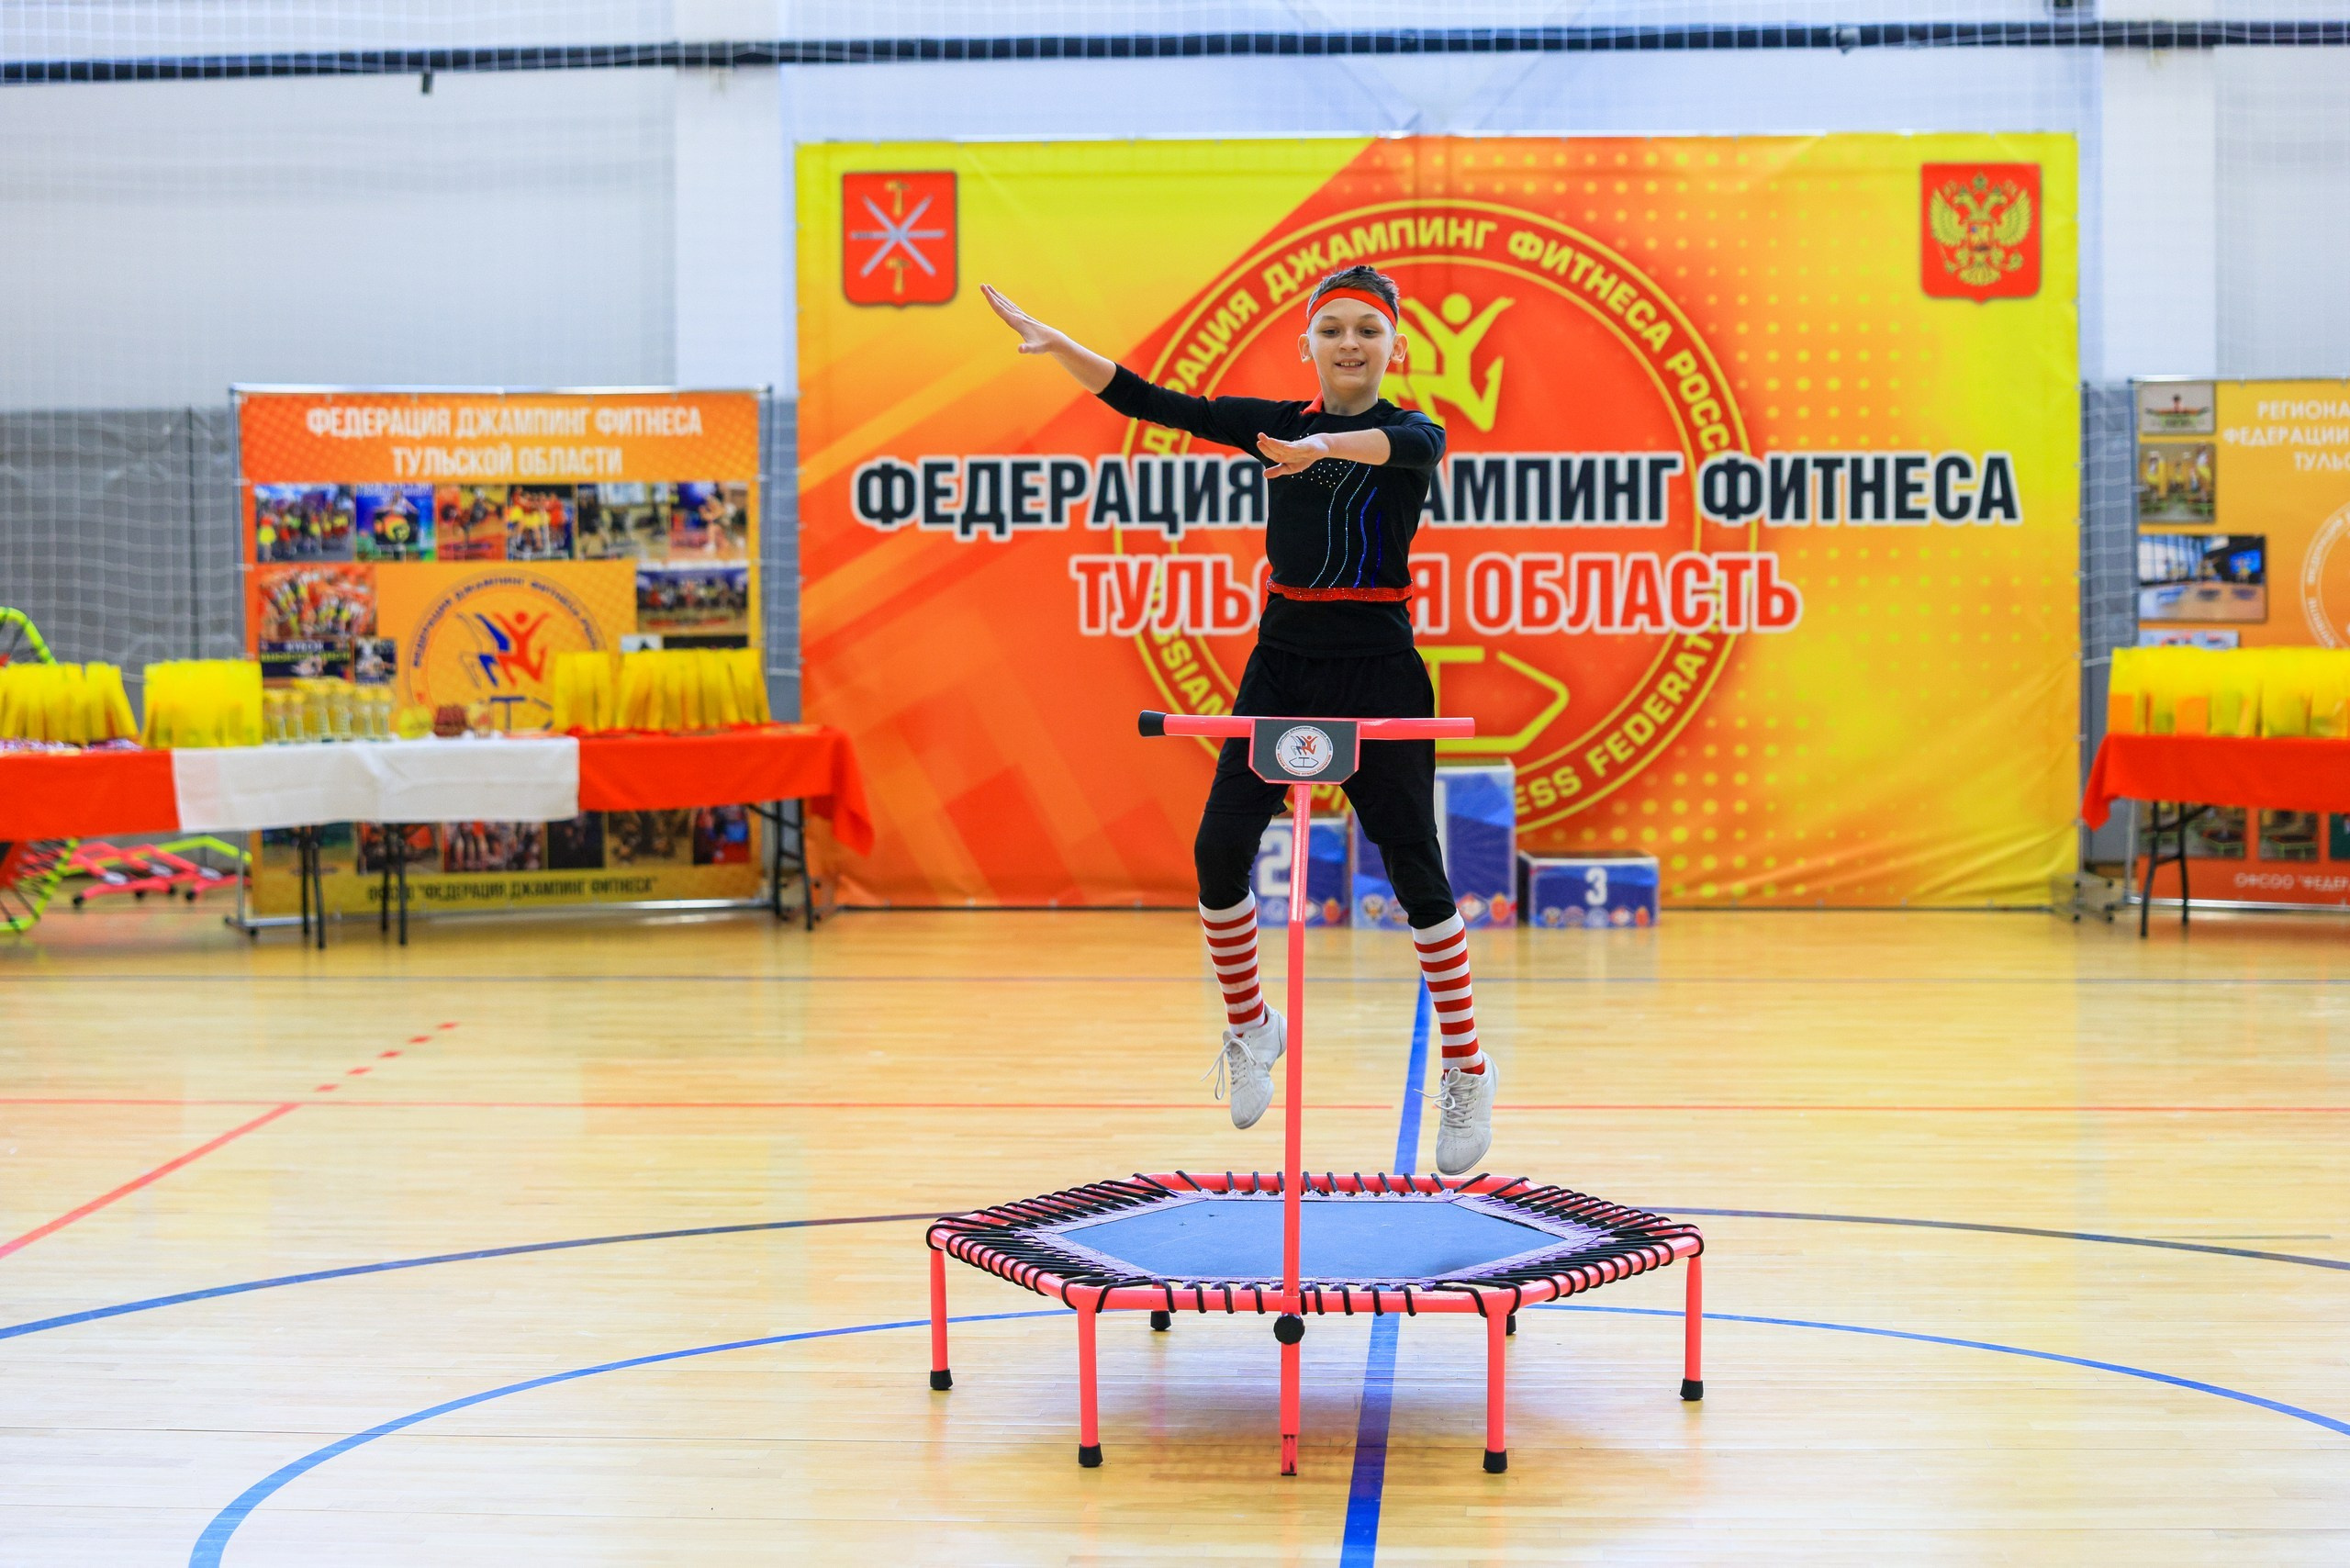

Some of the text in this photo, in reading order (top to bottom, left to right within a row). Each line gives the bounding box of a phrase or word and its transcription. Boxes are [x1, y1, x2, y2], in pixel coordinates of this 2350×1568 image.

[1262, 217, 1497, 302] ДЖАМПИНГ
[1507, 230, 1674, 353] ФИТНЕСА
[1664, 349, 1733, 460] РОСС
[306, 407, 704, 438] ФЕДЕРАЦИЯ ДЖАМПИНГ ФИТНЕСА
[391, 442, 623, 476] ТУЛЬСКОЙ ОБЛАСТИ
[852, 453, 2022, 542] ФЕДЕРАЦИЯ АМПИНГ ФИТНЕСА
[1070, 552, 1802, 636] ТУЛЬЯ ОБЛАСТЬ
[1584, 621, 1718, 778] FEDERAT
[1257, 828, 1292, 897] 2
[1585, 866, 1608, 906] 3
